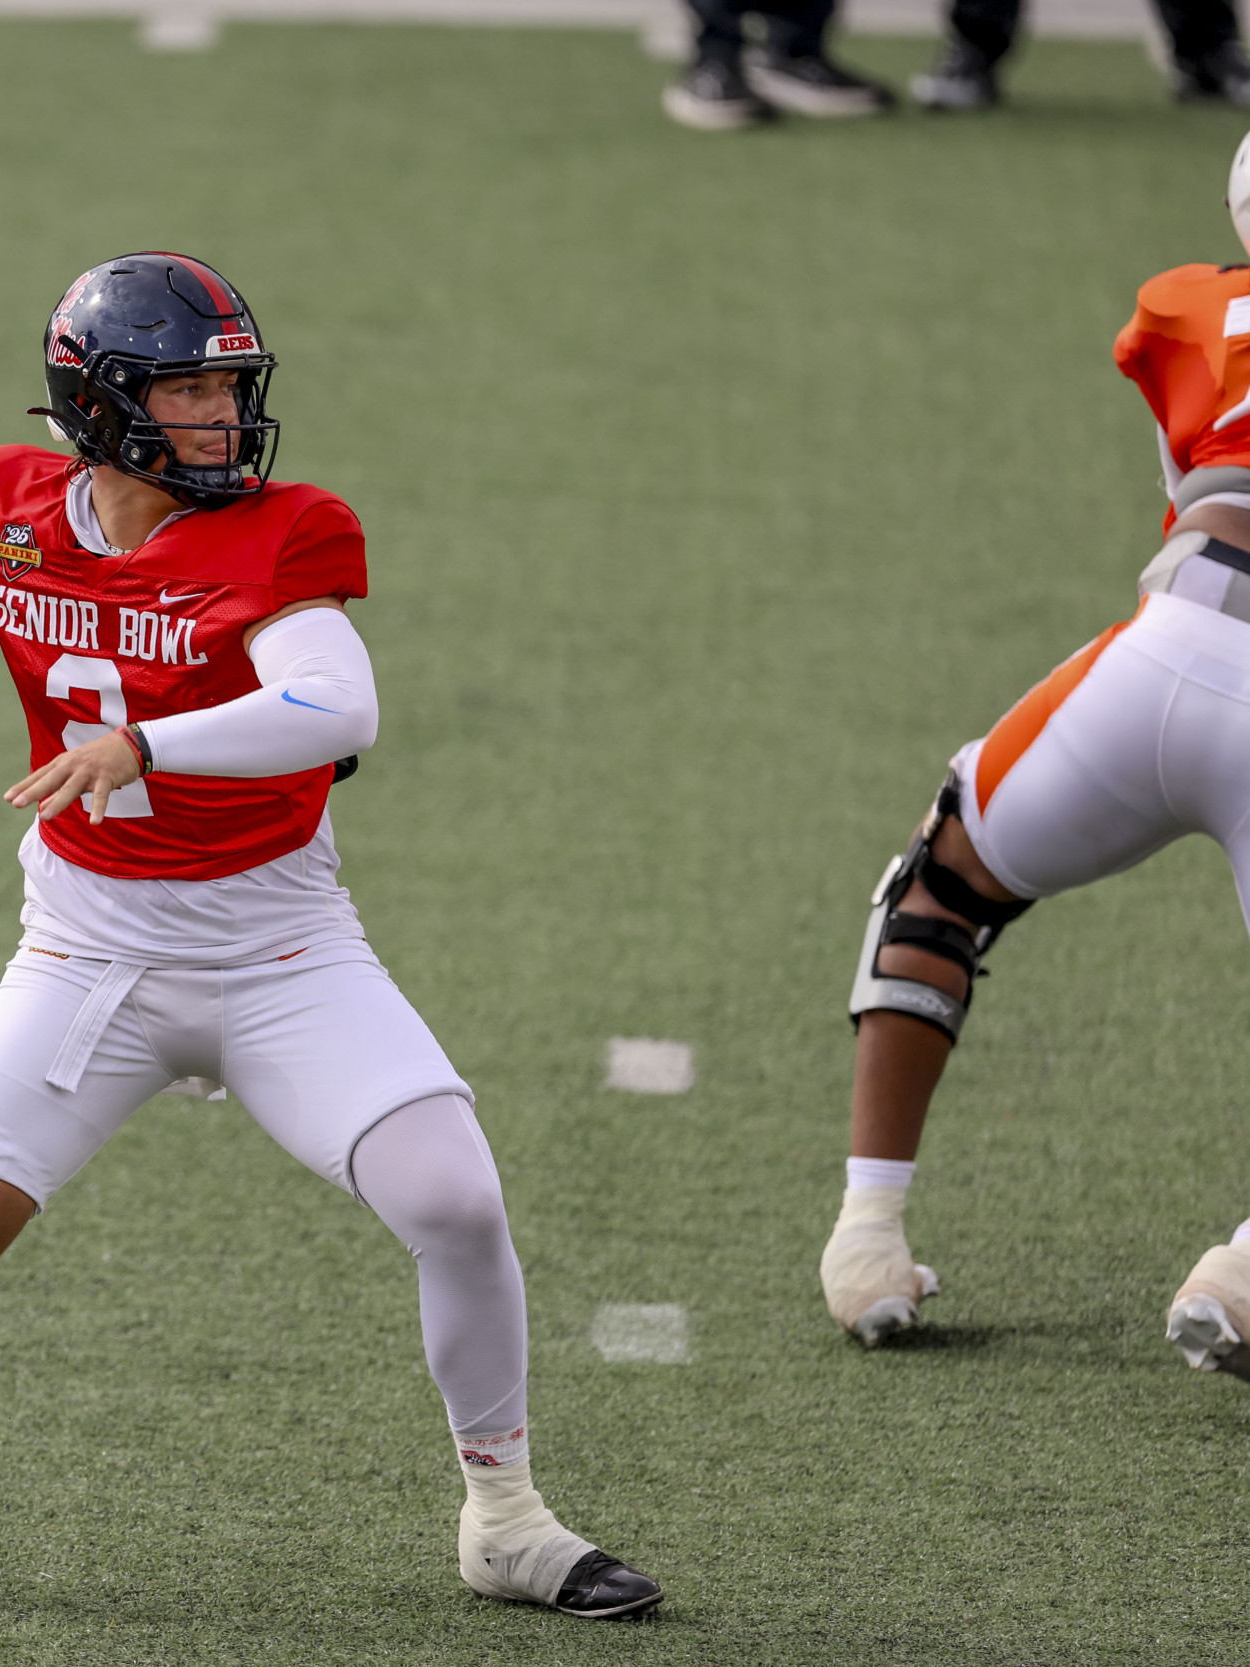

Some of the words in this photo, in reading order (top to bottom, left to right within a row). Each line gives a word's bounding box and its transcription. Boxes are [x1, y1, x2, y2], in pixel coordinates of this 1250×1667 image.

[217, 335, 255, 352] REBS
[5, 524, 31, 544] '25
[117, 606, 209, 666] BOWL
[45, 652, 155, 819] 2
